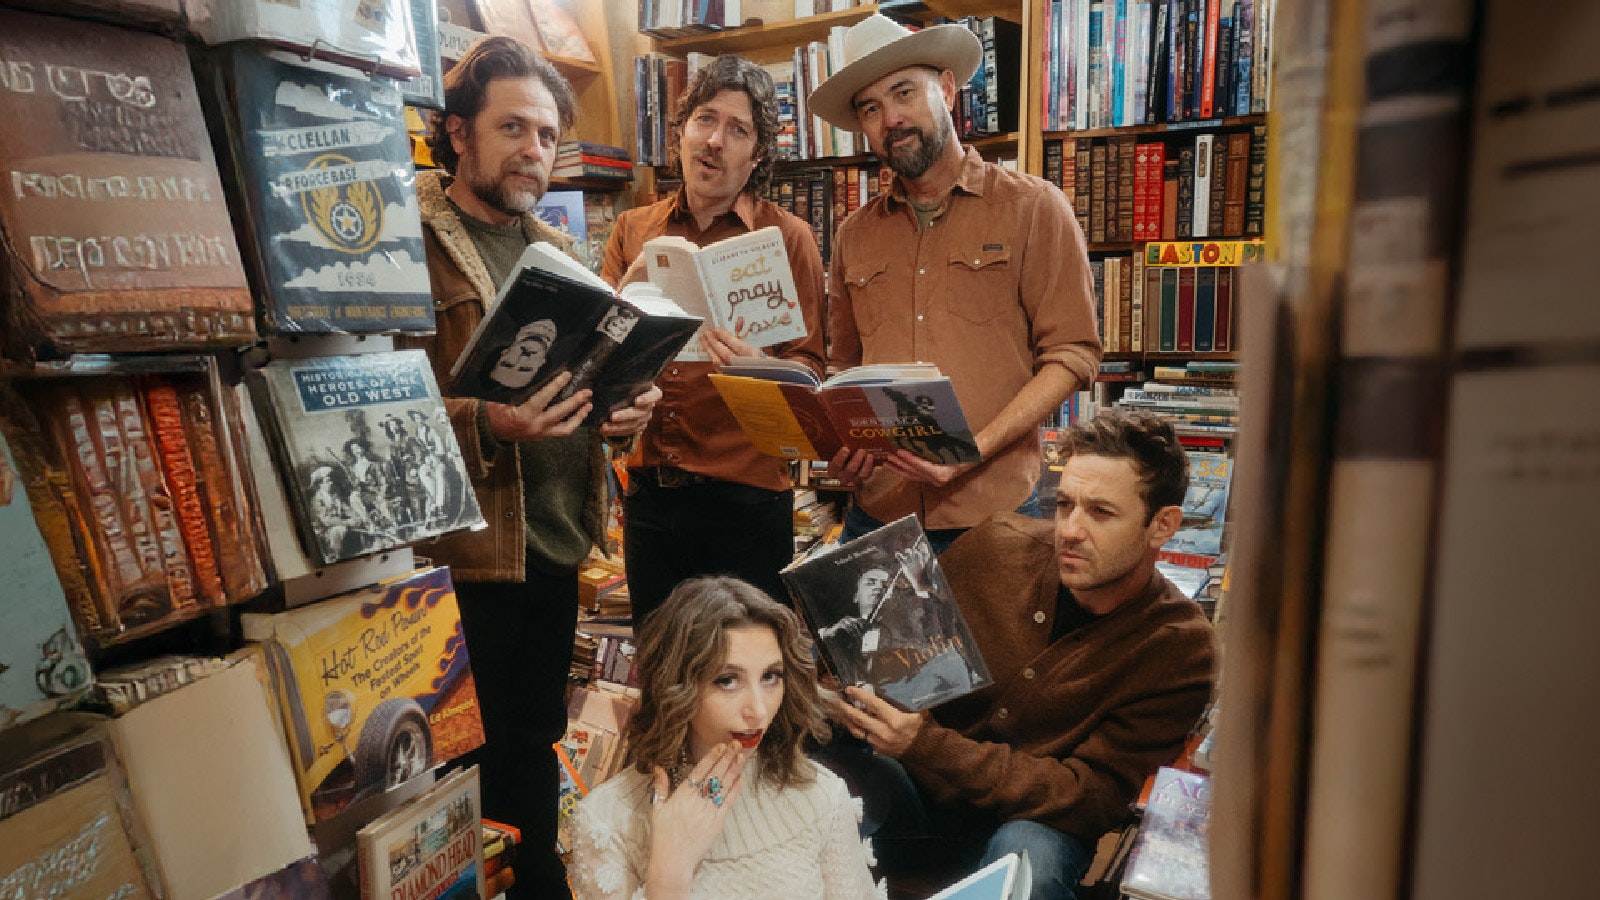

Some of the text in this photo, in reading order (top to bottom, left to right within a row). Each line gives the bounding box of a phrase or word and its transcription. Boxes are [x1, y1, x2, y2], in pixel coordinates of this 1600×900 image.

[1147, 243, 1236, 265] EASTON
[730, 255, 773, 282] eat
[727, 279, 789, 321] pray
[735, 312, 793, 339] love
[323, 386, 411, 406] OLD WEST
[849, 425, 943, 440] COWGIRL
[321, 645, 358, 686] Hot
[361, 623, 389, 659] Rod
[895, 632, 964, 669] Violin
[350, 668, 371, 688] The
[447, 828, 477, 872] HEAD
